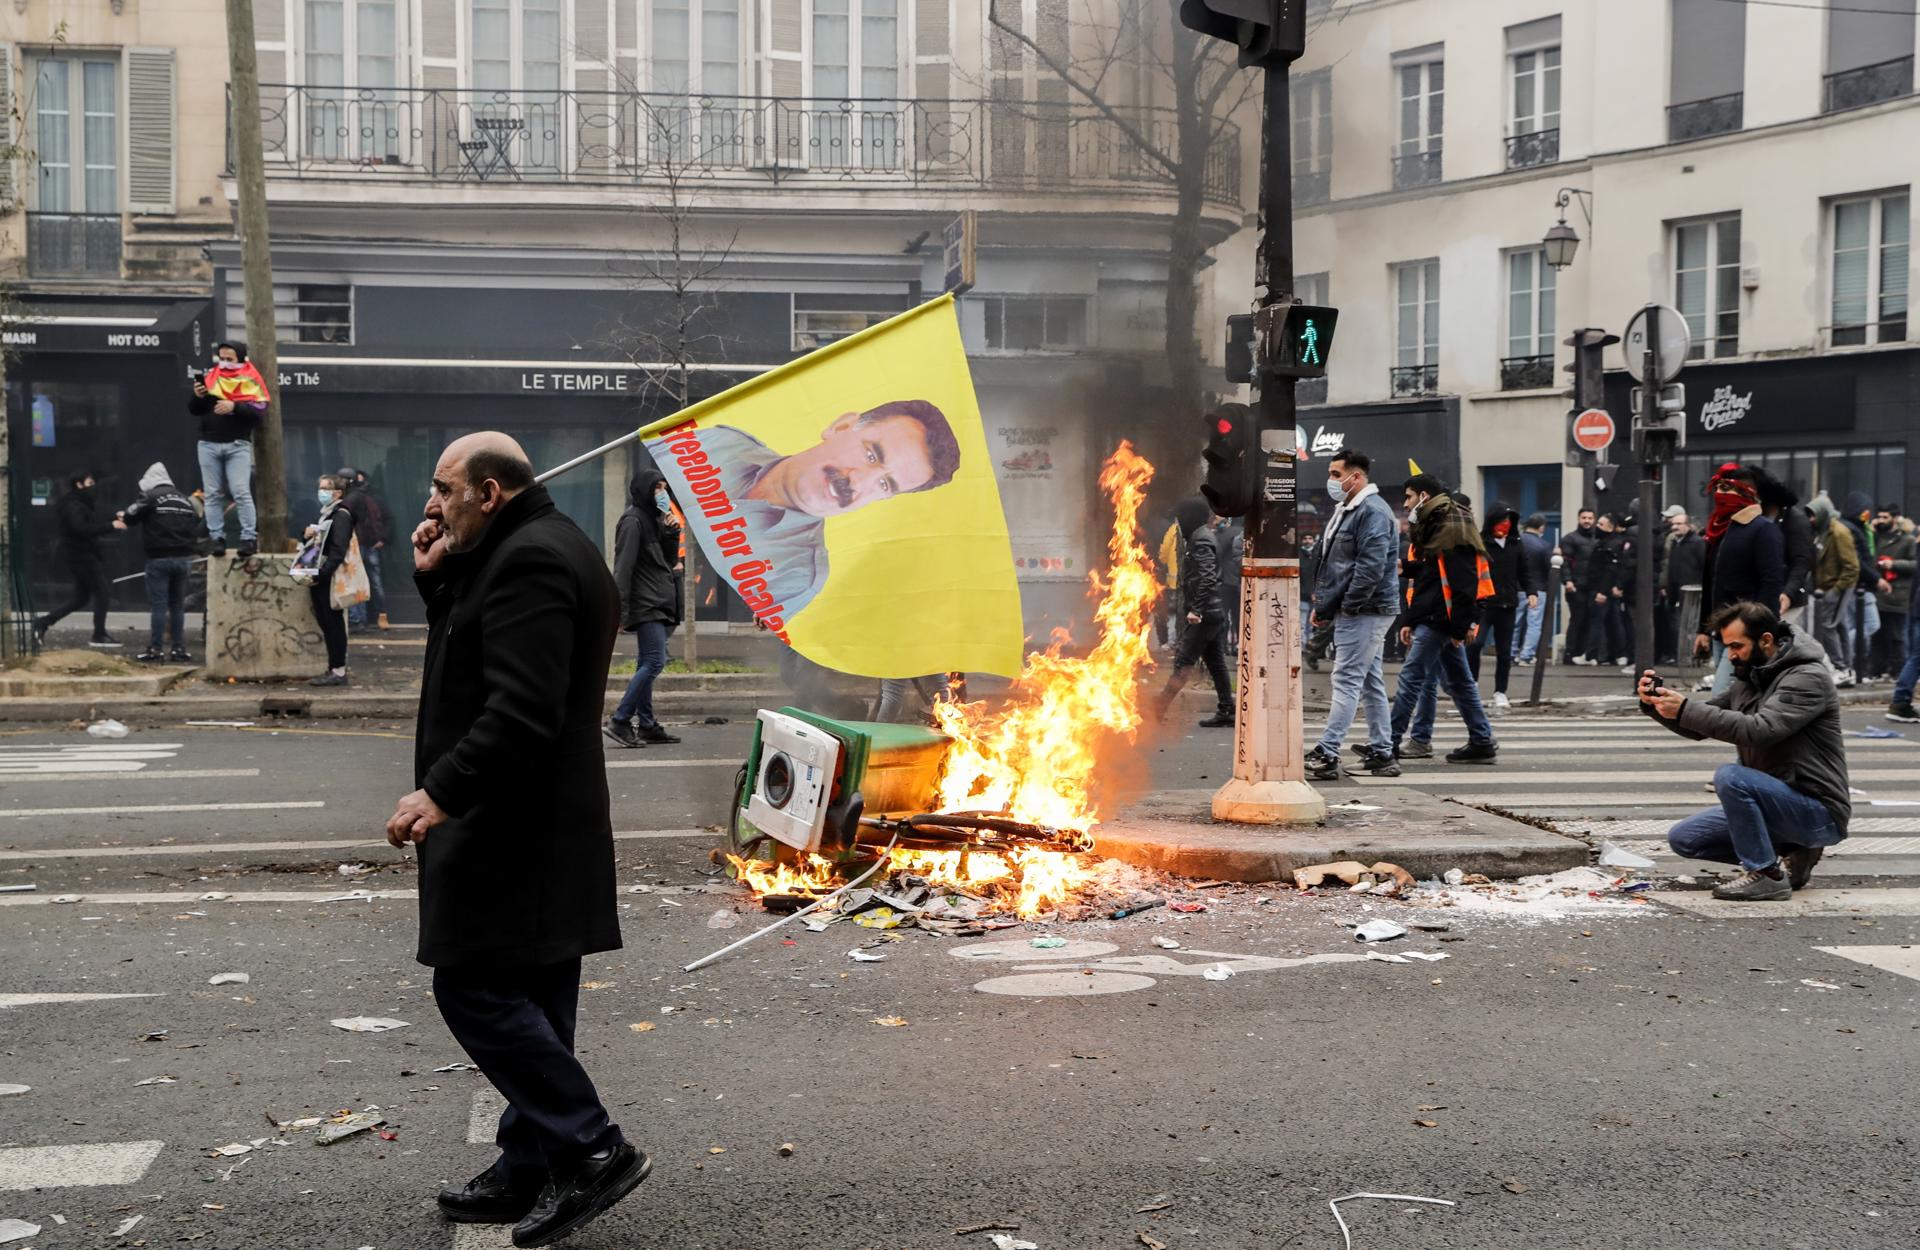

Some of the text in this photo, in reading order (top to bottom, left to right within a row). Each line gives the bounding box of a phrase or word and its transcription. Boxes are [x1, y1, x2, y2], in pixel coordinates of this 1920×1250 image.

[108, 334, 160, 347] HOT DOG
[294, 372, 320, 386] Thé
[522, 373, 628, 391] LE TEMPLE
[659, 418, 734, 519] Freedom
[709, 516, 753, 559] For
